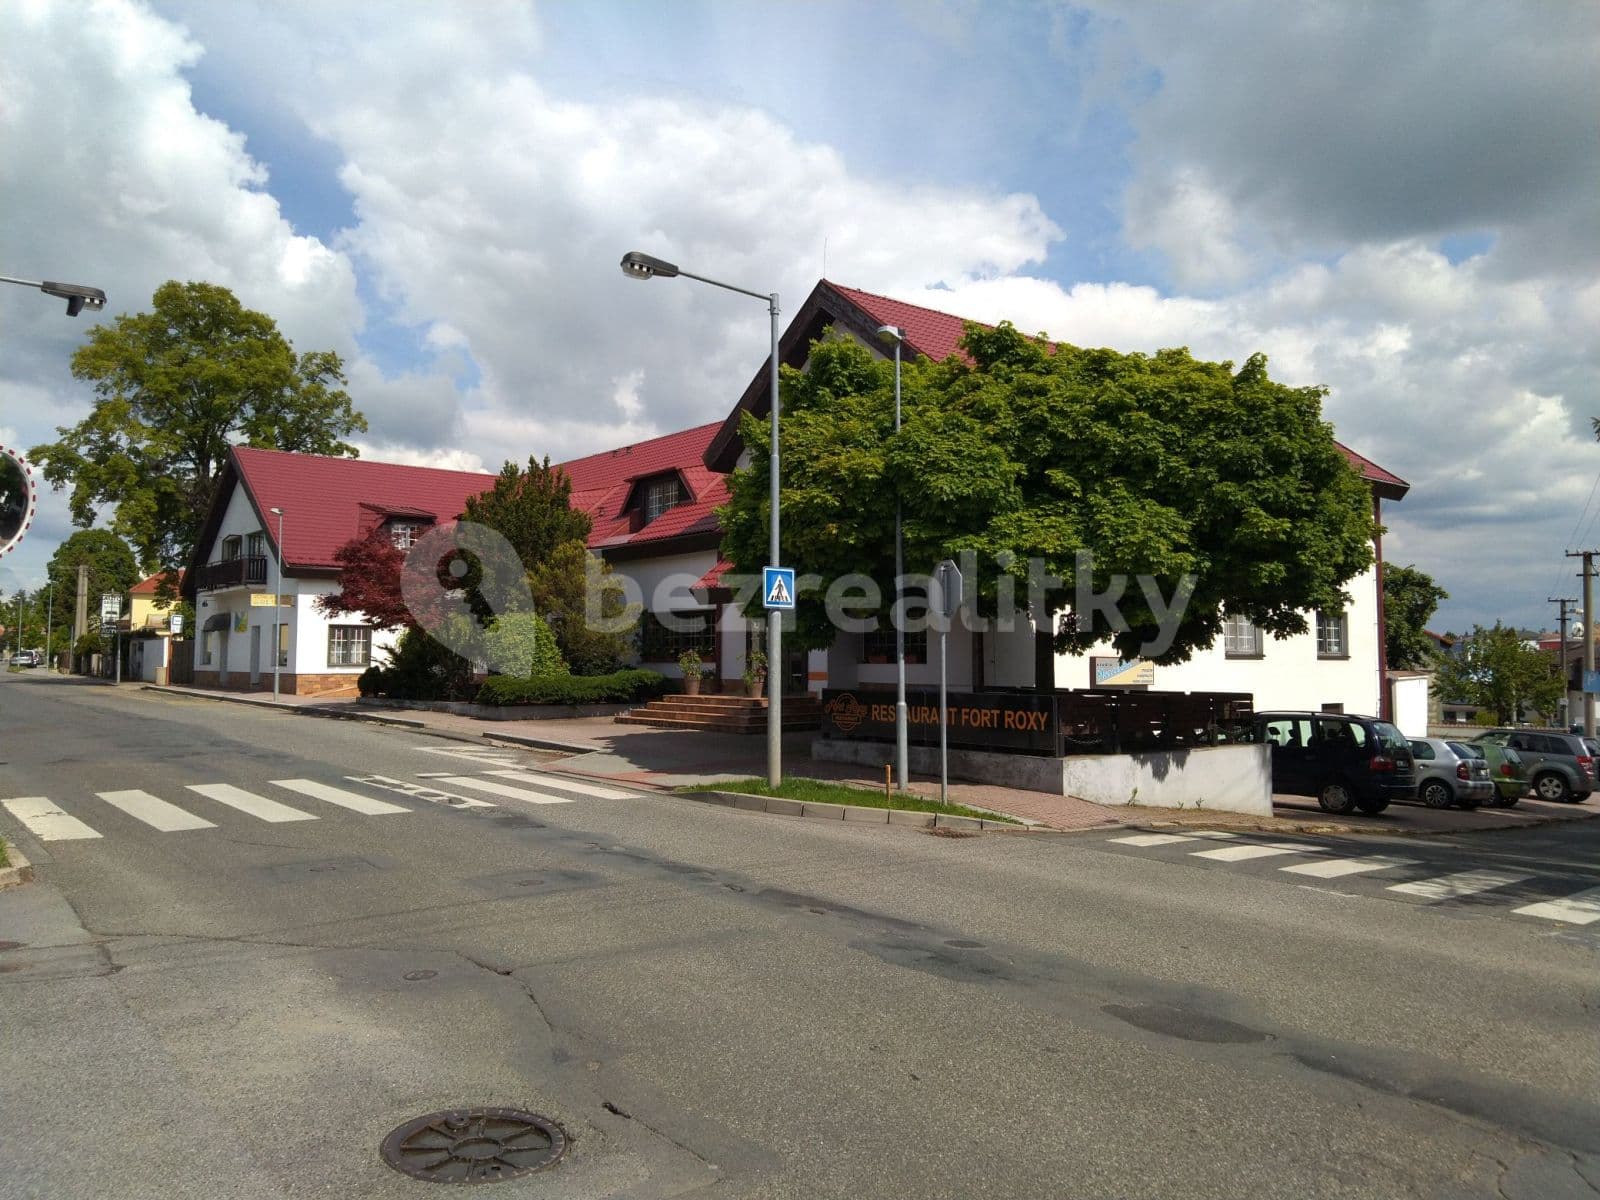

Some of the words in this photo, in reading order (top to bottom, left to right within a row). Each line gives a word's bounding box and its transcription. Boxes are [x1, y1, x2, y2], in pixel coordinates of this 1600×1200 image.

[871, 704, 958, 725] RESURAT
[961, 707, 1000, 729] FORT
[1004, 710, 1048, 732] ROXY
